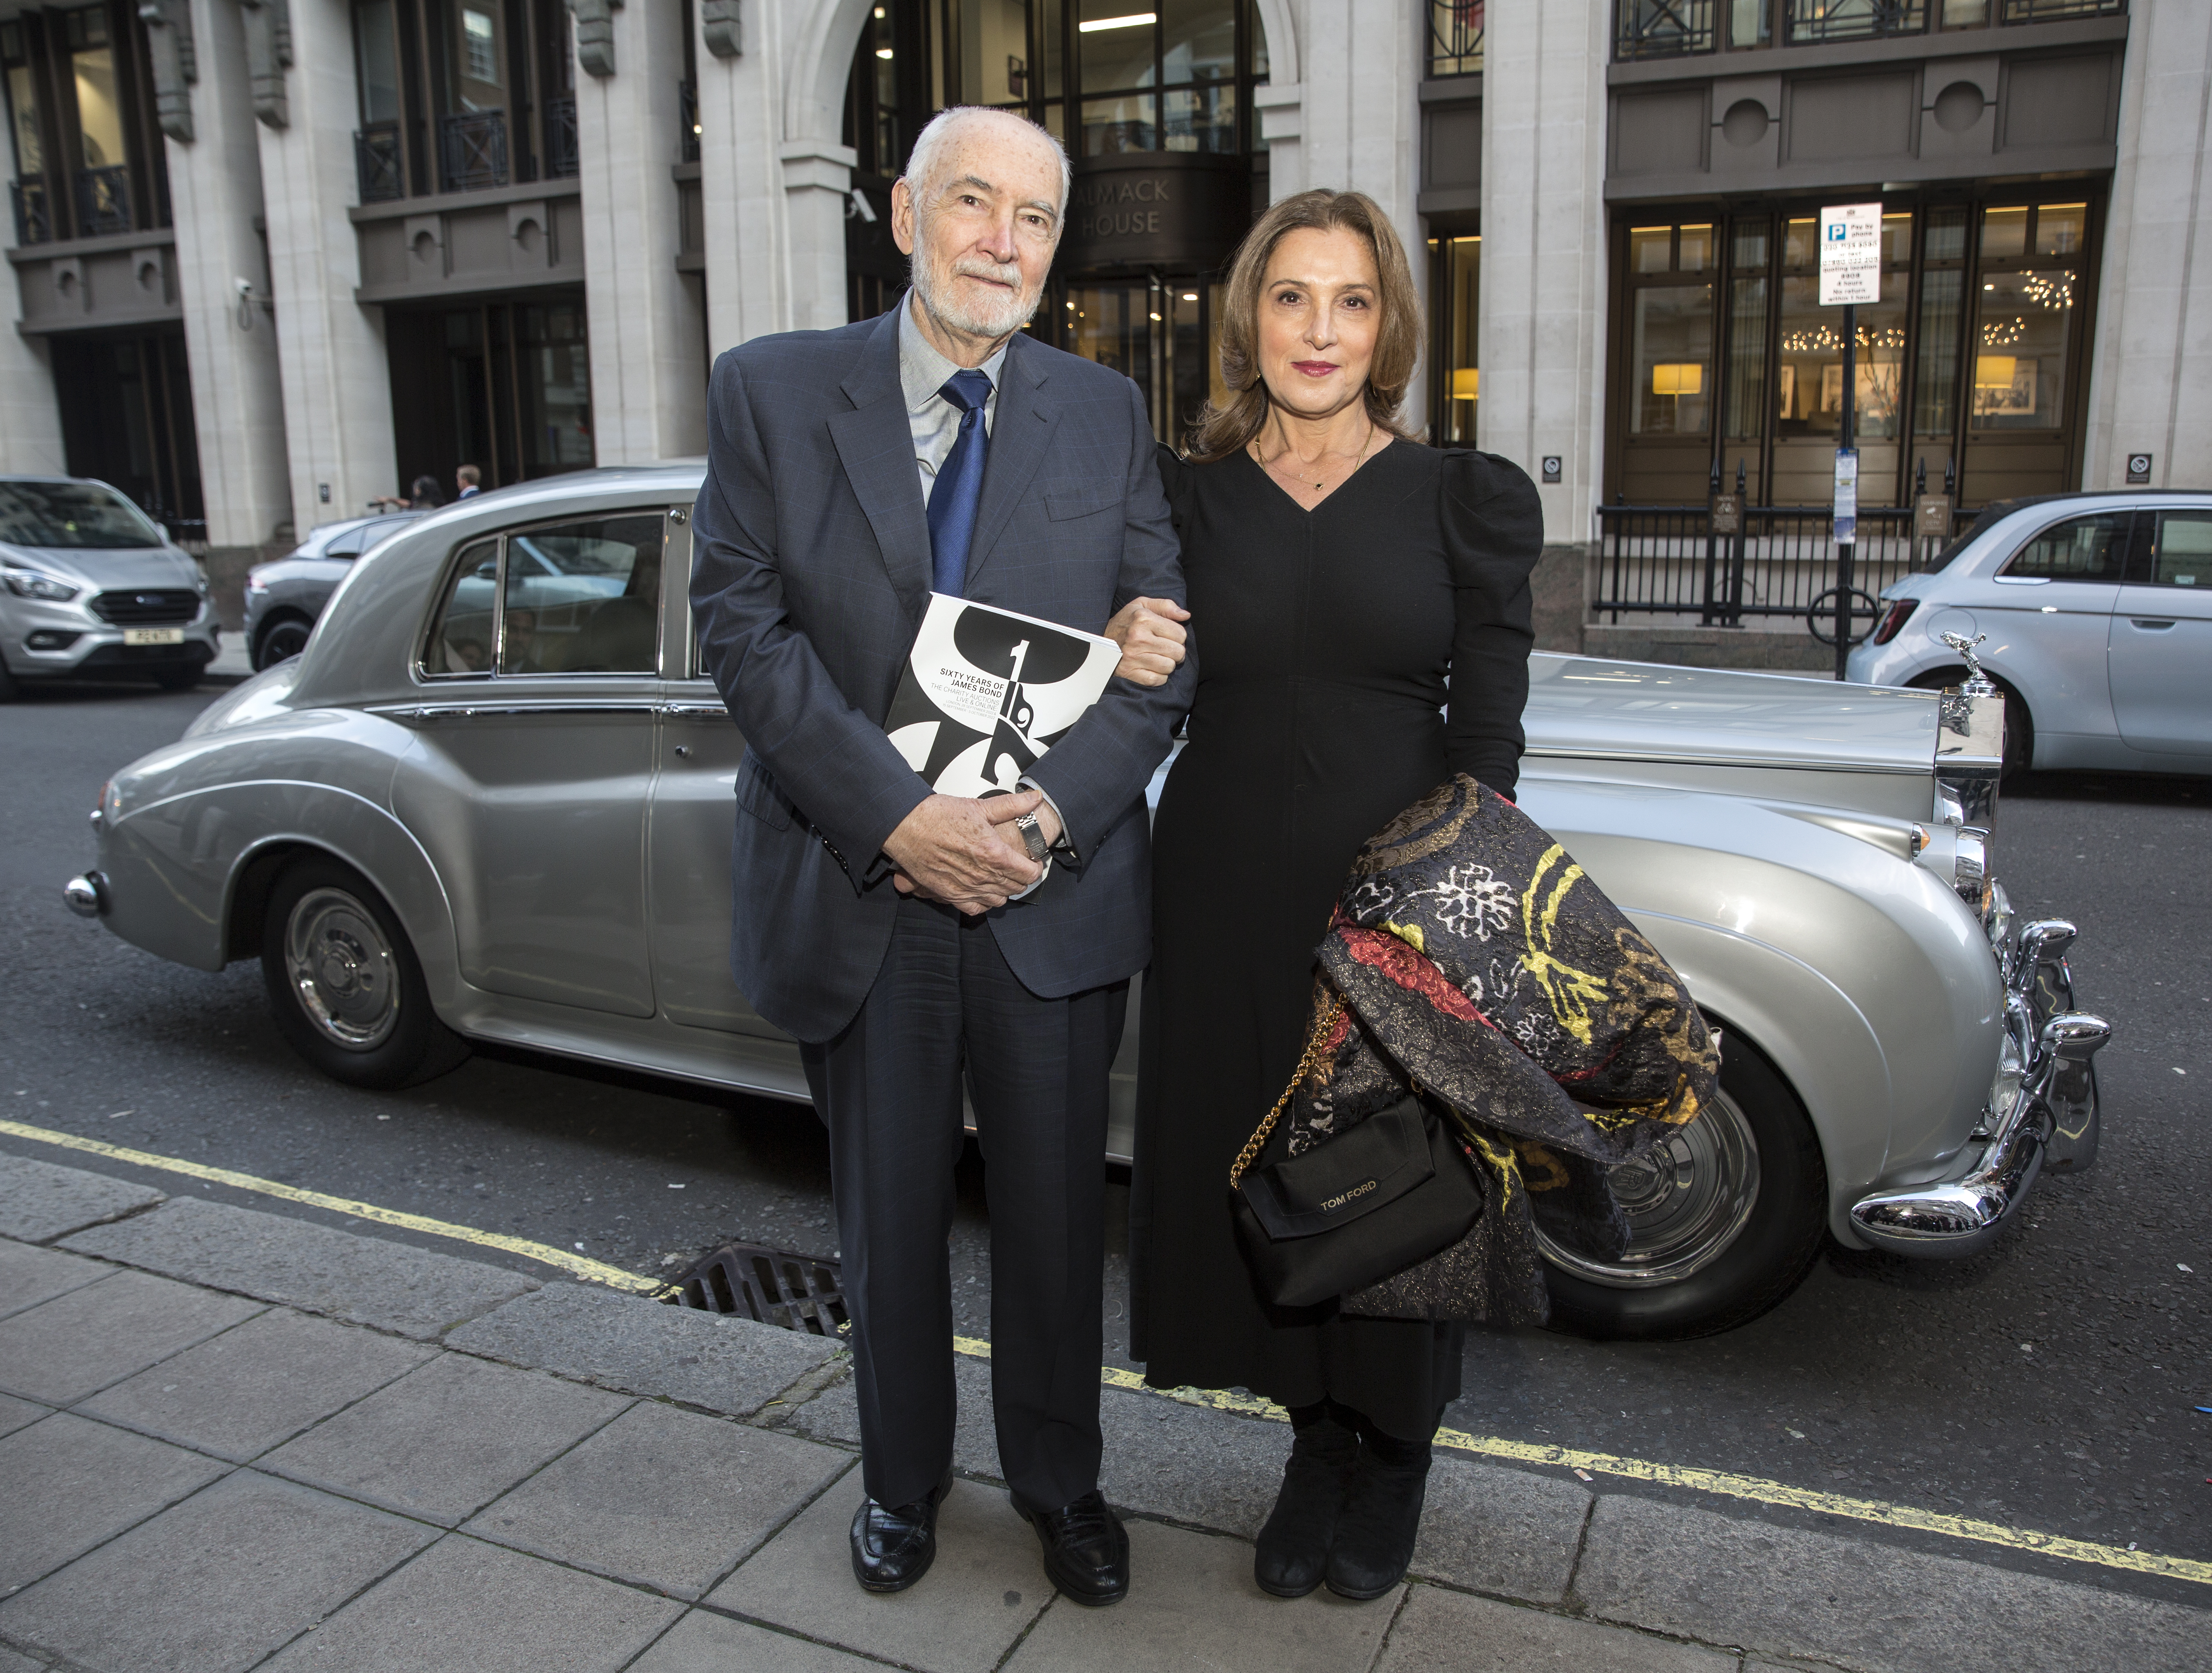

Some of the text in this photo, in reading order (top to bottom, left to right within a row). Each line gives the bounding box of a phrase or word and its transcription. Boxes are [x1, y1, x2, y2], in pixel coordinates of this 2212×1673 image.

[1082, 211, 1160, 237] HOUSE
[940, 668, 1005, 691] SIXTY YEARS OF
[951, 679, 1002, 698] JAMES BOND
[931, 682, 1000, 706] THE CHARITY AUCTIONS
[956, 696, 969, 704] LIVE
[975, 701, 998, 711] ONLINE:
[1320, 1181, 1376, 1210] TOM FORD
